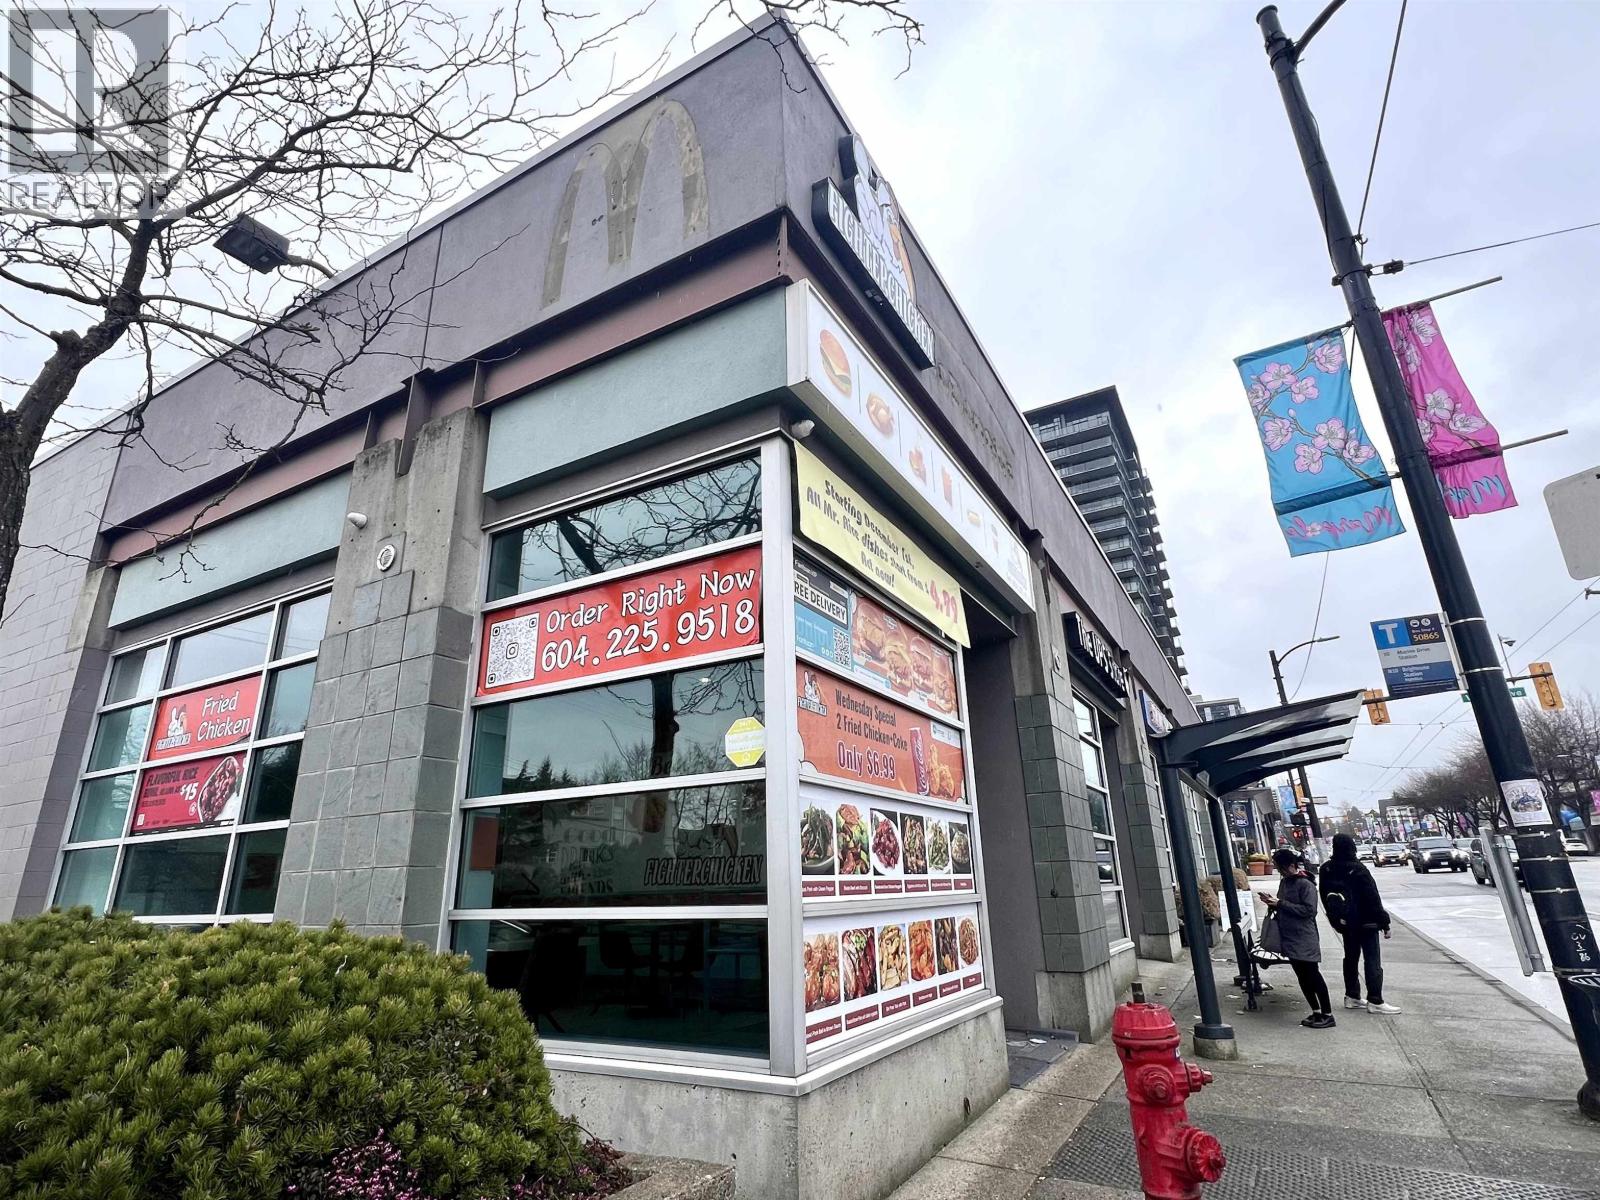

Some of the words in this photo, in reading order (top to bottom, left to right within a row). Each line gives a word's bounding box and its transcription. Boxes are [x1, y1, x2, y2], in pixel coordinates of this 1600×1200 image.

[806, 486, 821, 510] All
[823, 499, 840, 525] Mr.
[842, 515, 860, 541] Rice
[861, 533, 889, 562] dishes
[824, 479, 862, 526] Starting
[863, 513, 899, 556] December
[545, 603, 608, 634] Order
[620, 578, 687, 617] Right
[699, 568, 756, 599] Now
[810, 590, 846, 621] DELIVERY
[541, 599, 757, 672] 604.225.9518
[1412, 631, 1440, 642] 50865
[202, 690, 239, 718] Fried
[835, 688, 873, 721] Wednesday
[874, 704, 897, 728] Special
[197, 717, 251, 742] Chicken
[836, 713, 842, 730] 2
[844, 715, 862, 737] Fried
[837, 740, 863, 776] Only
[866, 746, 896, 780] $6.99
[180, 781, 199, 801] $15
[643, 855, 764, 887] FIGHTERCHICKEN
